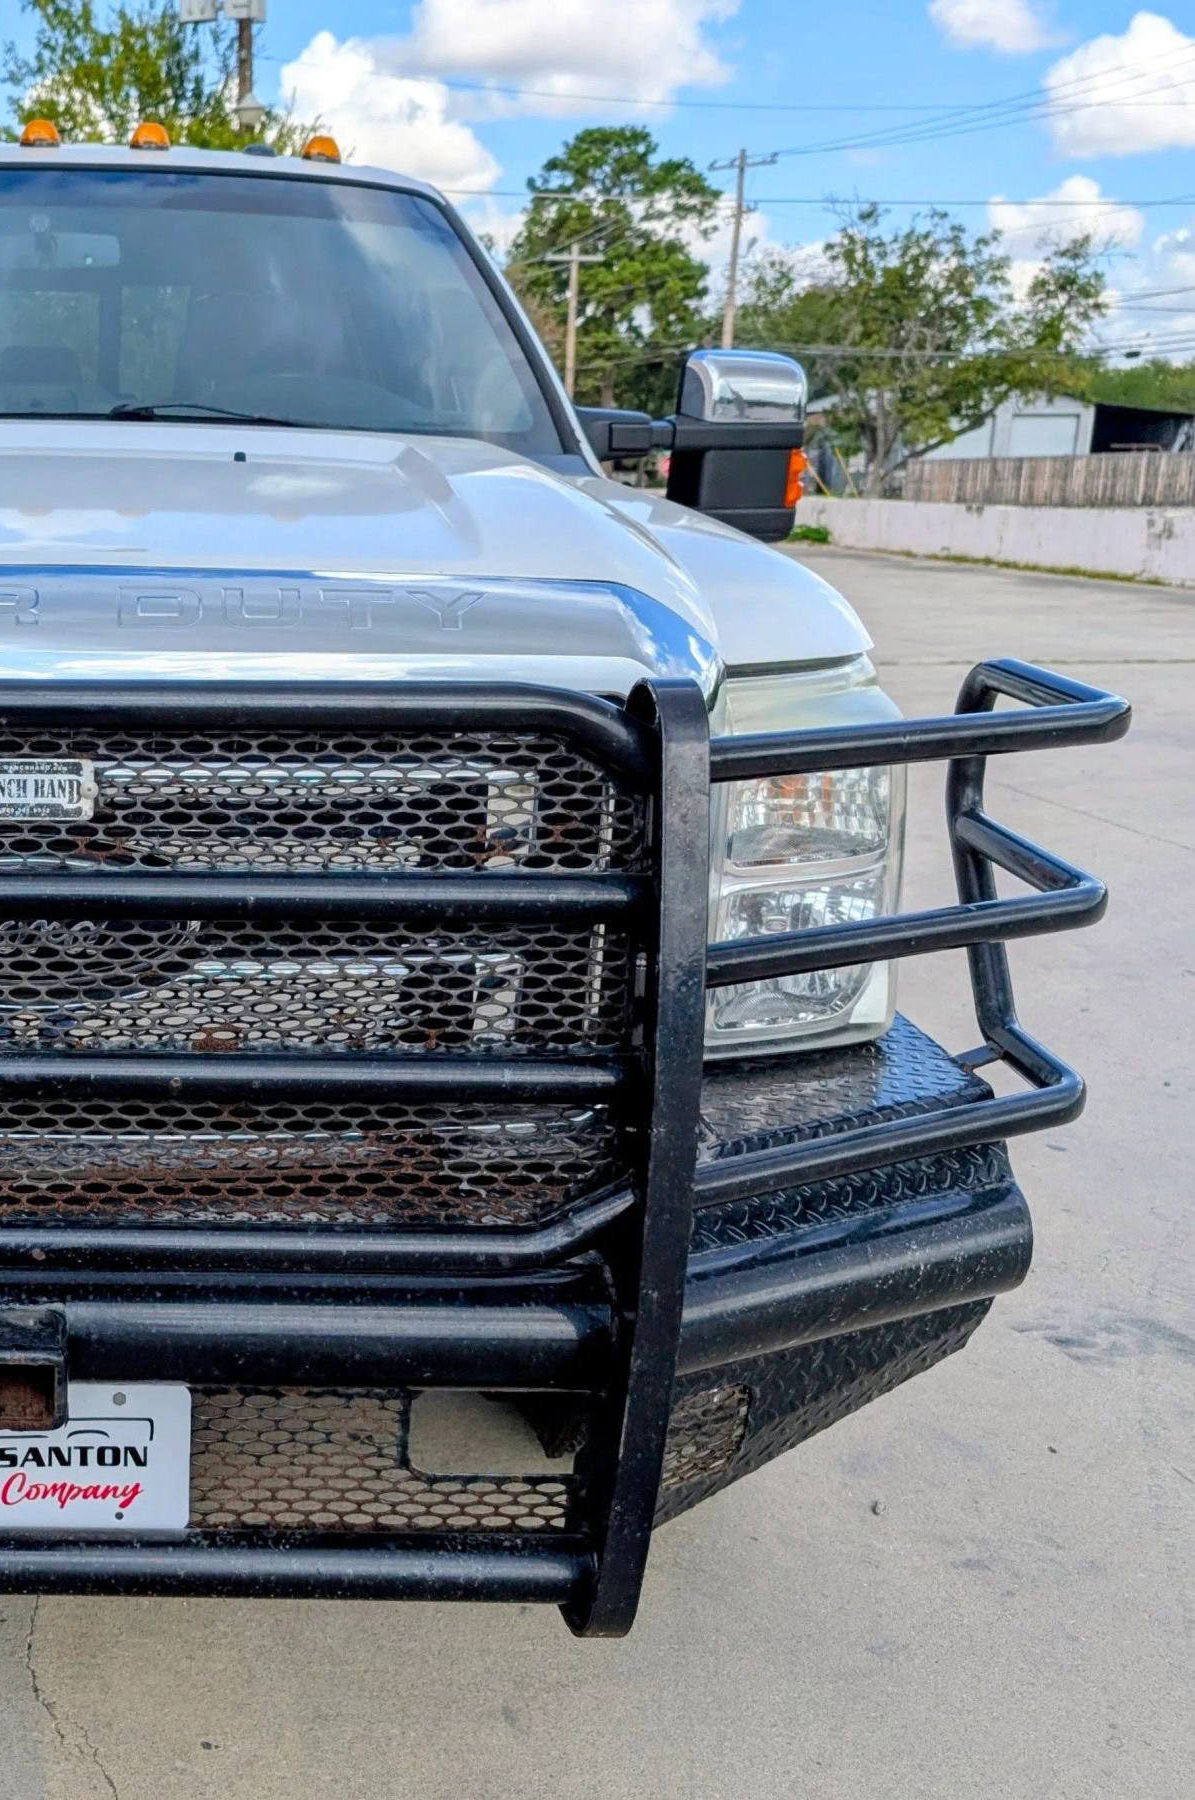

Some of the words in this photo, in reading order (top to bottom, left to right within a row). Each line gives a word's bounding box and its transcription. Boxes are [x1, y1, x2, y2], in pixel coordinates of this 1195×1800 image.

[116, 585, 489, 631] DUTY
[33, 778, 83, 804] HAND
[0, 1472, 145, 1509] Company
